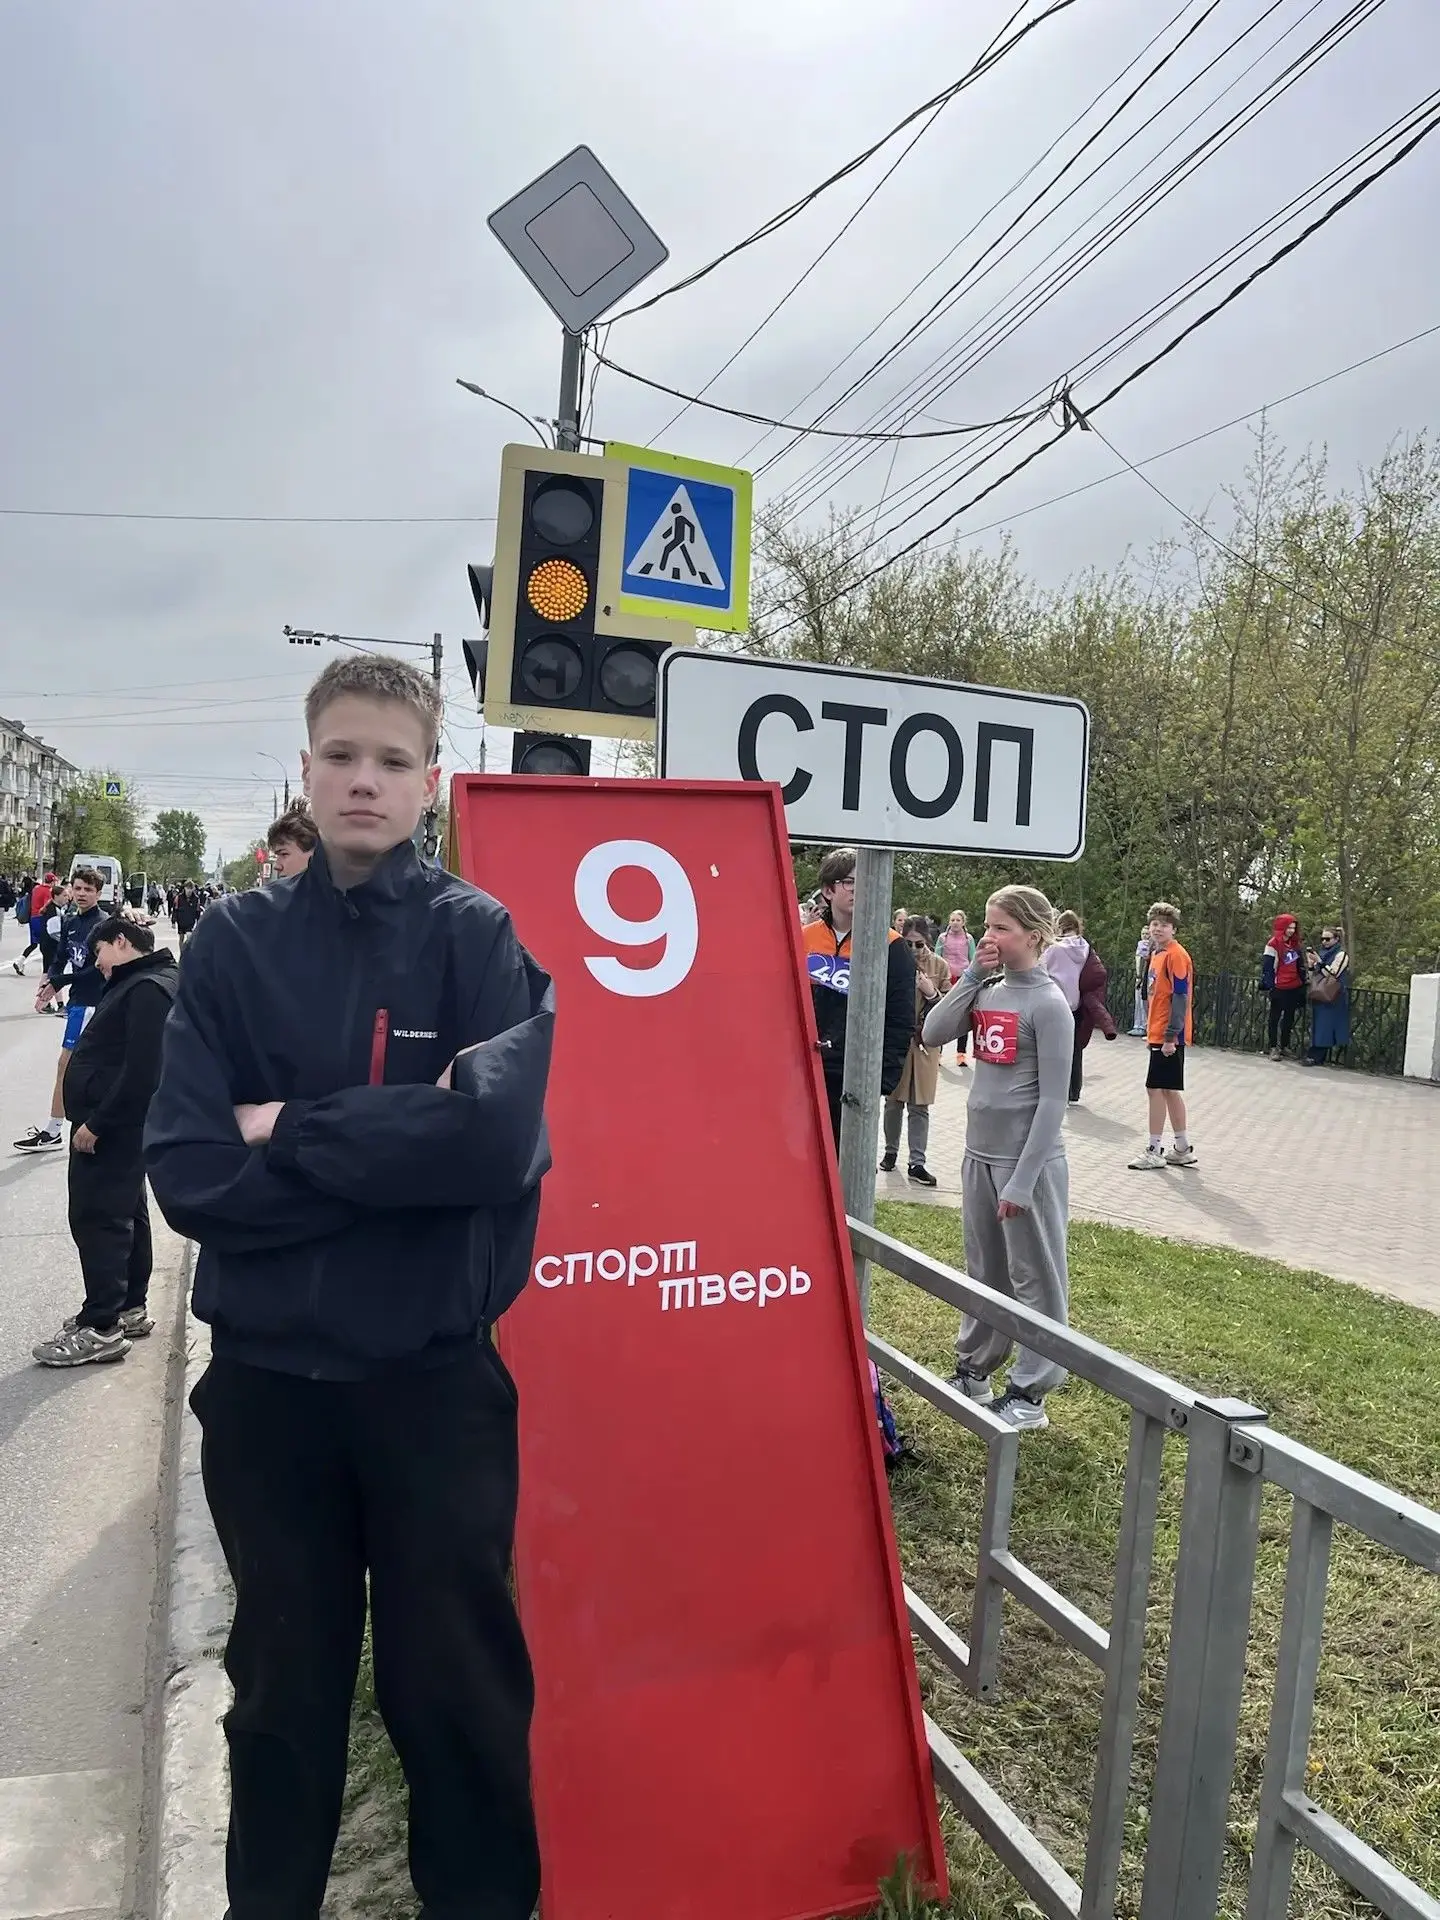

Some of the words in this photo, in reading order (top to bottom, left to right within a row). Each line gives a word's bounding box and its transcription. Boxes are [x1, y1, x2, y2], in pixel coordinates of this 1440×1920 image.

[737, 693, 1035, 827] СТОП
[574, 839, 699, 998] 9
[810, 965, 850, 989] 46
[975, 1024, 1005, 1054] 46
[534, 1240, 697, 1287] спорт
[658, 1265, 812, 1311] тверь
